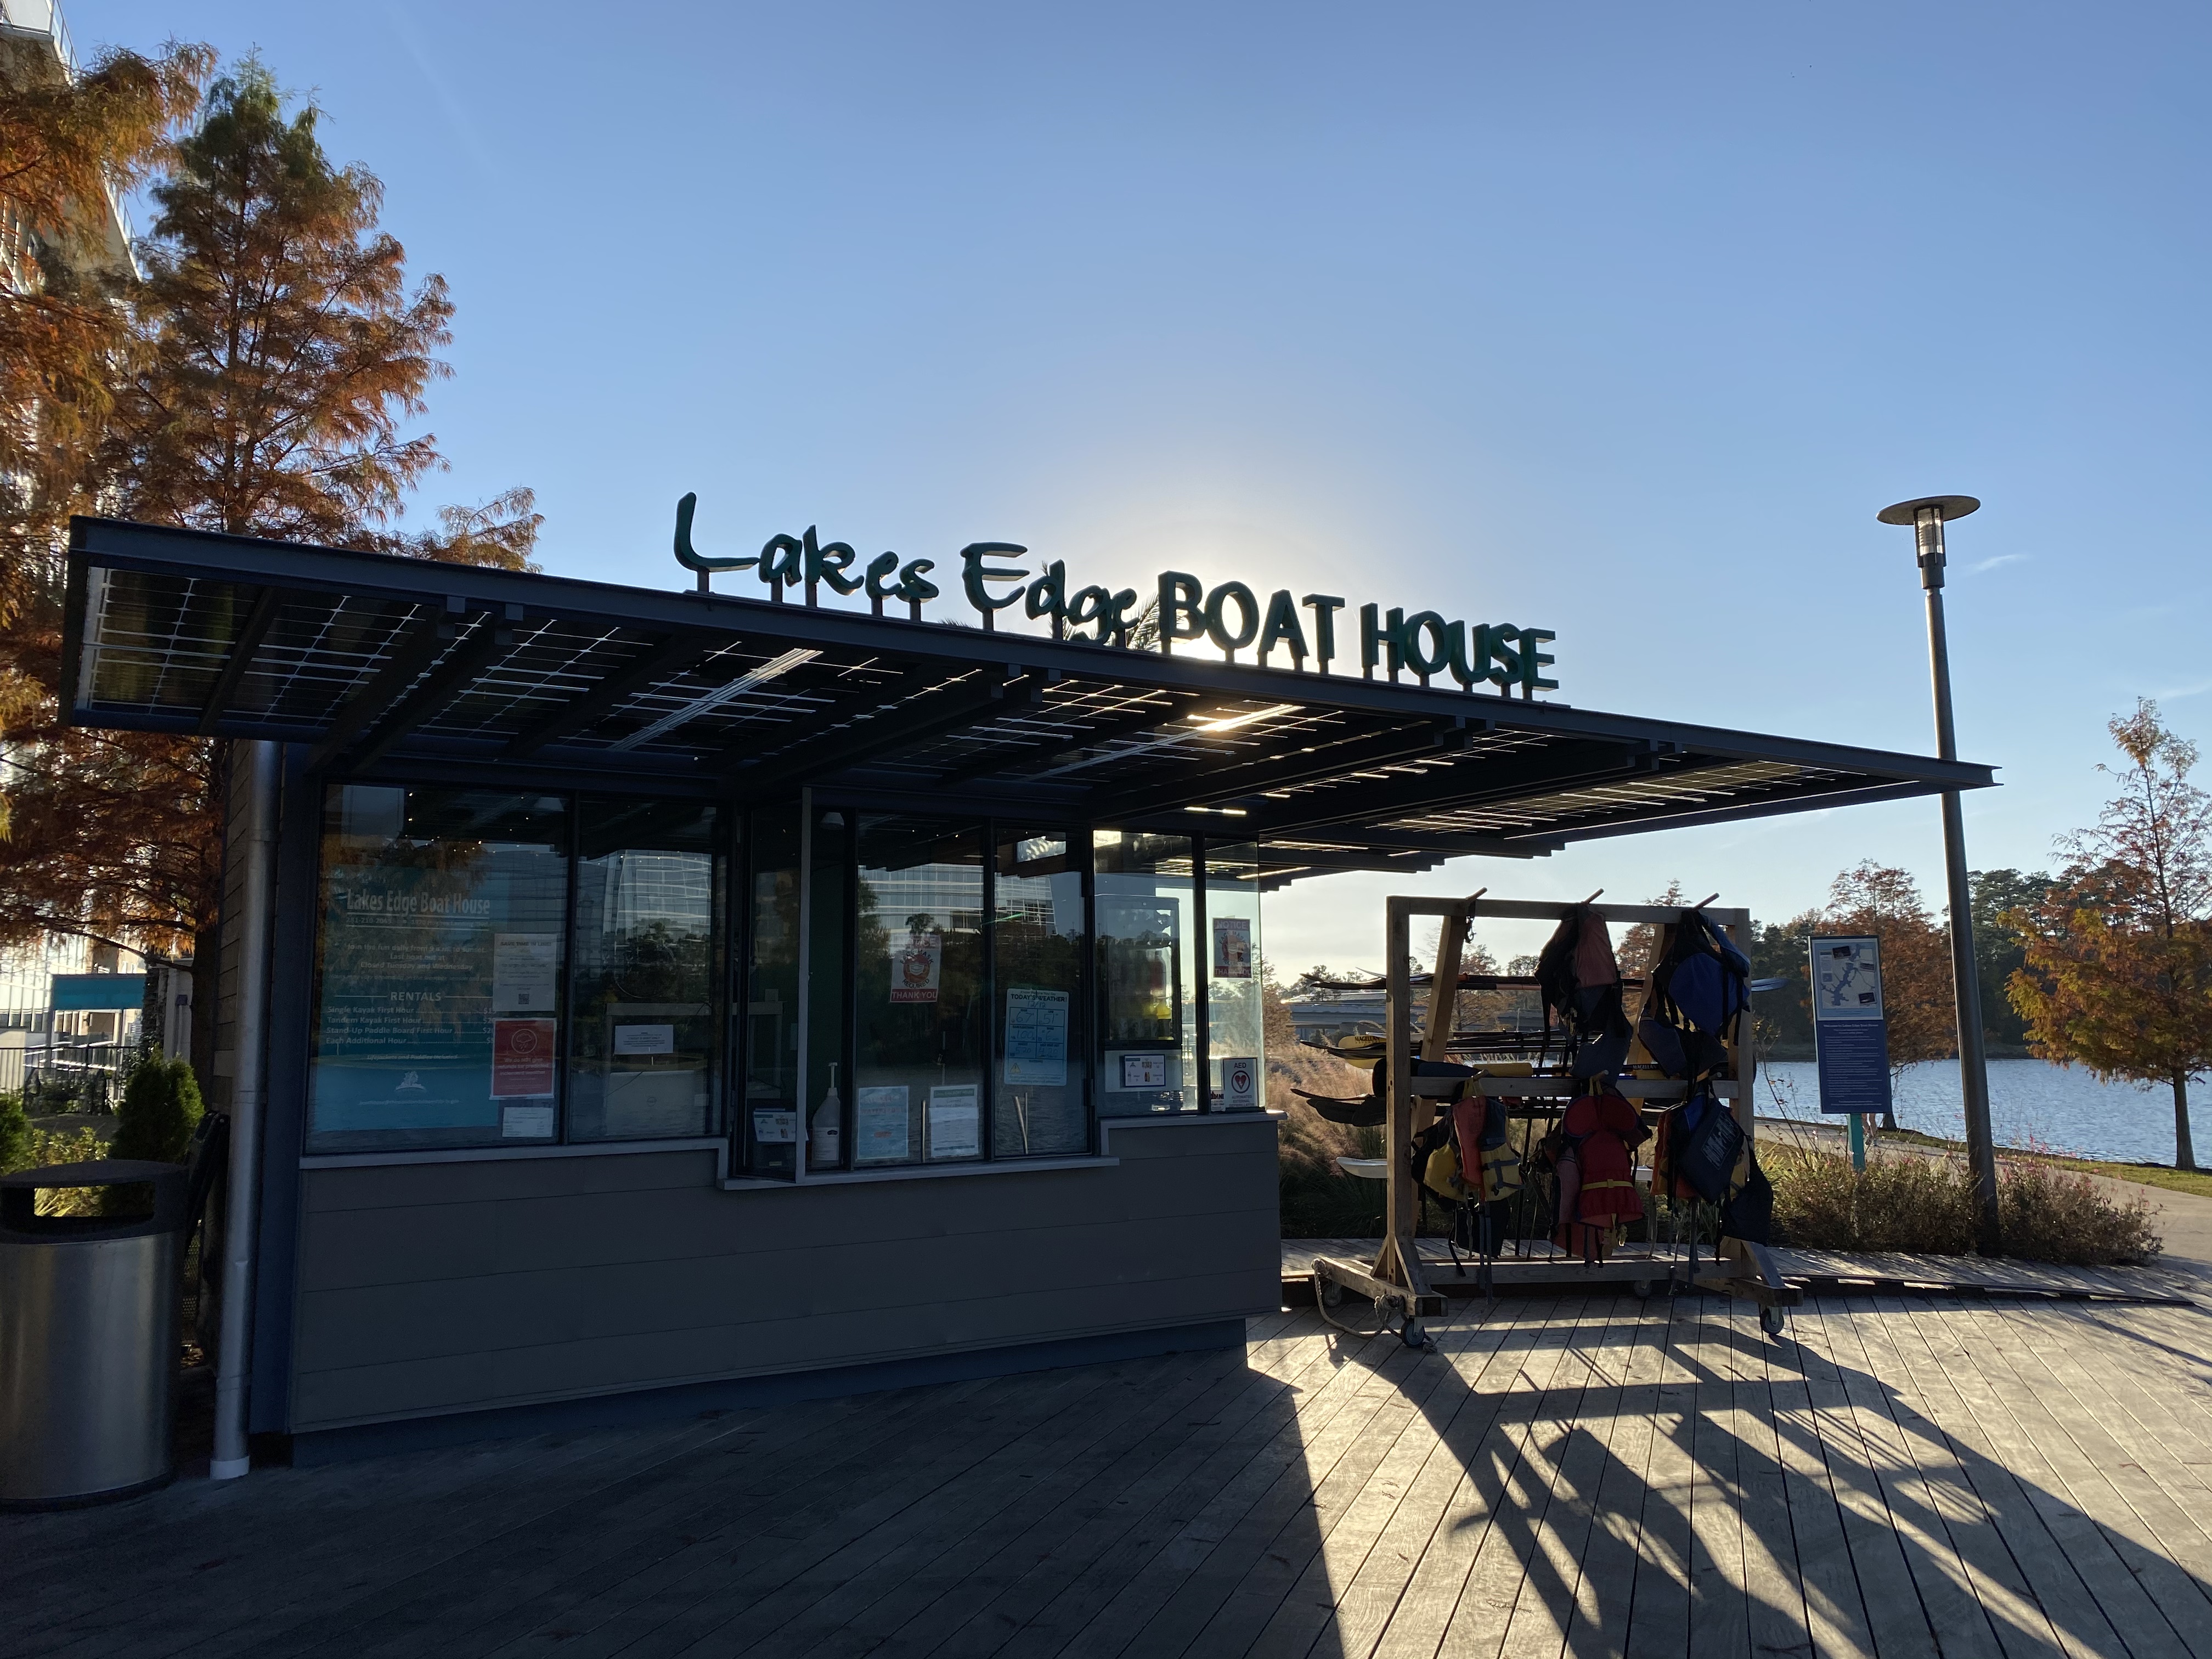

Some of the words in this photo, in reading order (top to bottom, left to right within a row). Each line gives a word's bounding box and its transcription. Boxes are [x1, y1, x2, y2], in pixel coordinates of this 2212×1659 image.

[674, 492, 939, 603] Lakes
[960, 541, 1139, 647] Edge
[1158, 571, 1345, 659] BOAT
[1360, 602, 1559, 692] HOUSE
[347, 889, 383, 911] Lakes
[386, 890, 417, 916] Edge
[420, 891, 450, 913] Boat
[453, 893, 490, 915] House
[1218, 931, 1229, 944] FACE
[432, 963, 473, 971] Wednesday
[902, 978, 930, 989] REQUIRED
[390, 992, 442, 1002] RENTALS
[328, 1006, 351, 1015] Single
[360, 1017, 382, 1025] Kayak
